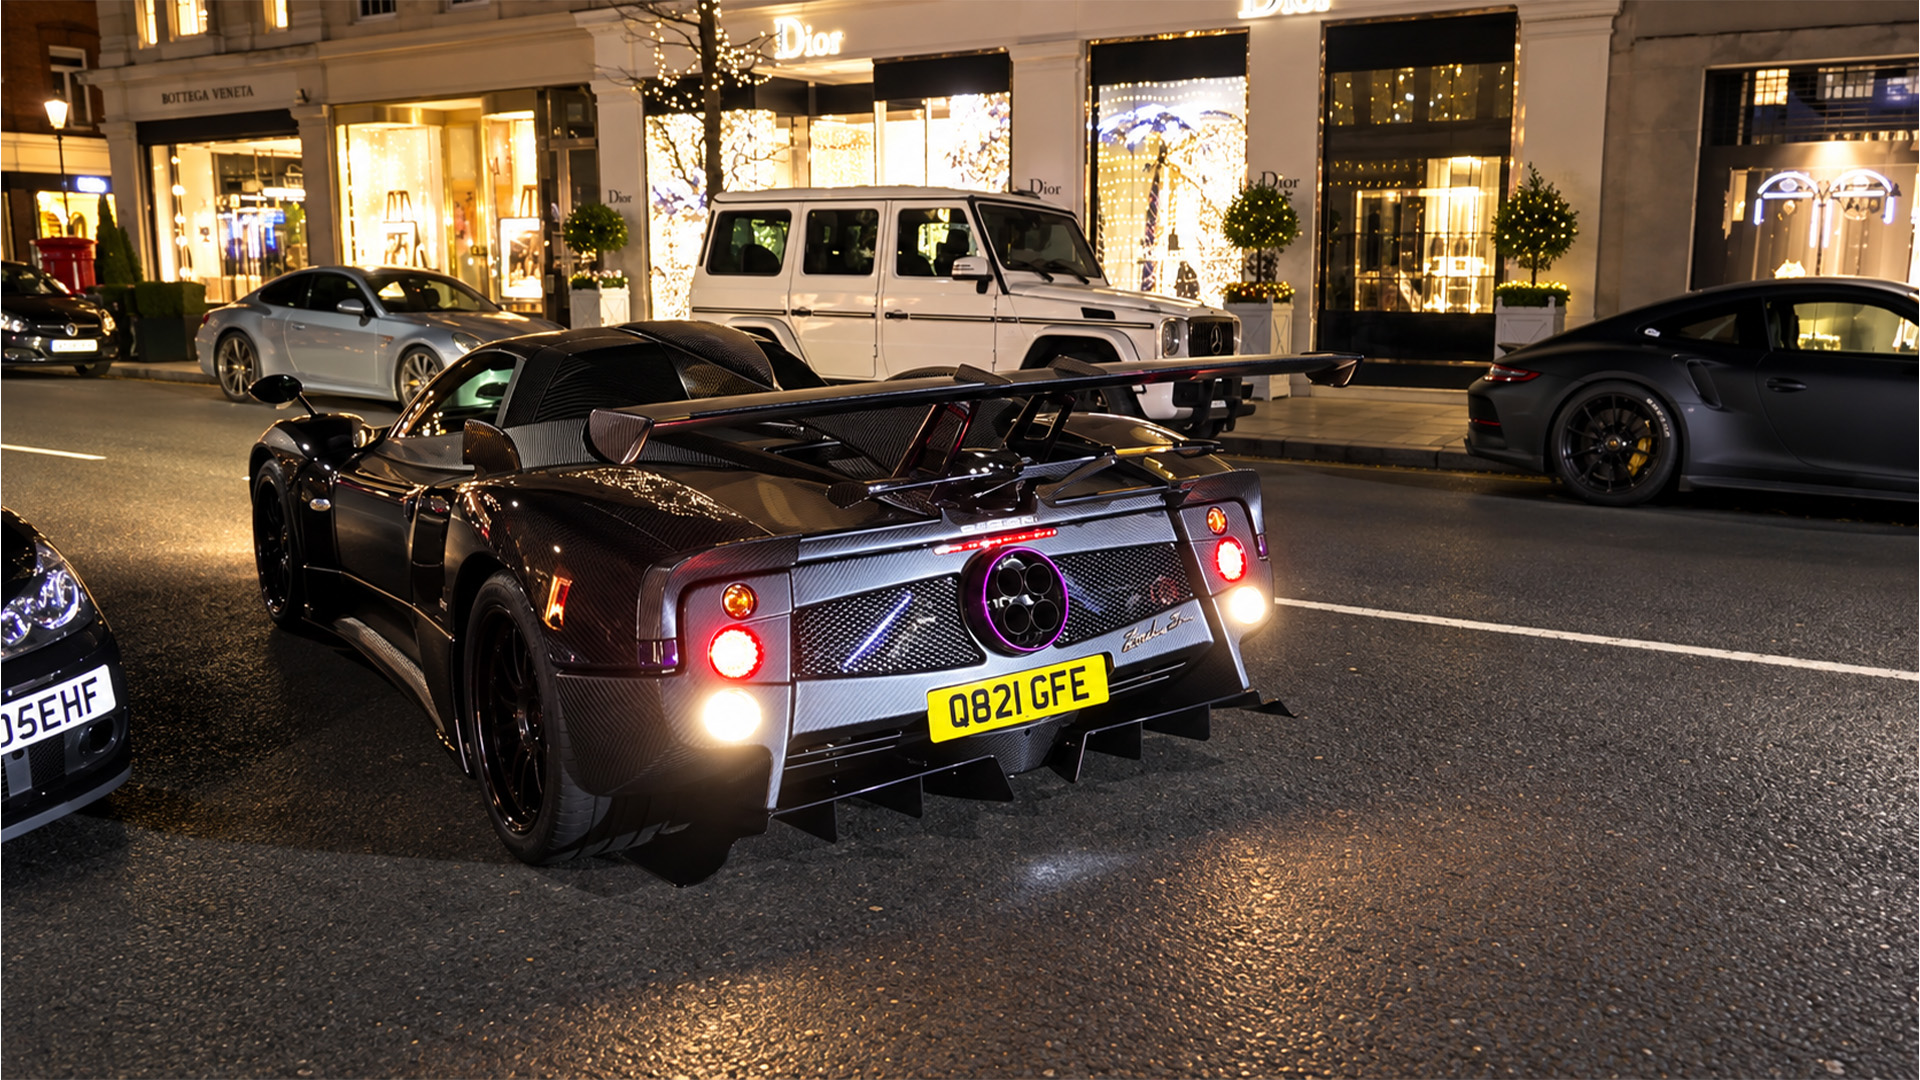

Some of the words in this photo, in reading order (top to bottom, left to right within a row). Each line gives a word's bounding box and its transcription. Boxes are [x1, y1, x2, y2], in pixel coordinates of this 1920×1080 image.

[774, 17, 843, 59] Dior
[161, 89, 209, 104] BOTTEGA
[212, 85, 254, 99] VENETA
[1029, 178, 1061, 195] Dior
[1261, 171, 1300, 189] Dior
[608, 189, 632, 204] Dior
[949, 681, 1022, 728] Q821
[1030, 665, 1090, 710] GFE
